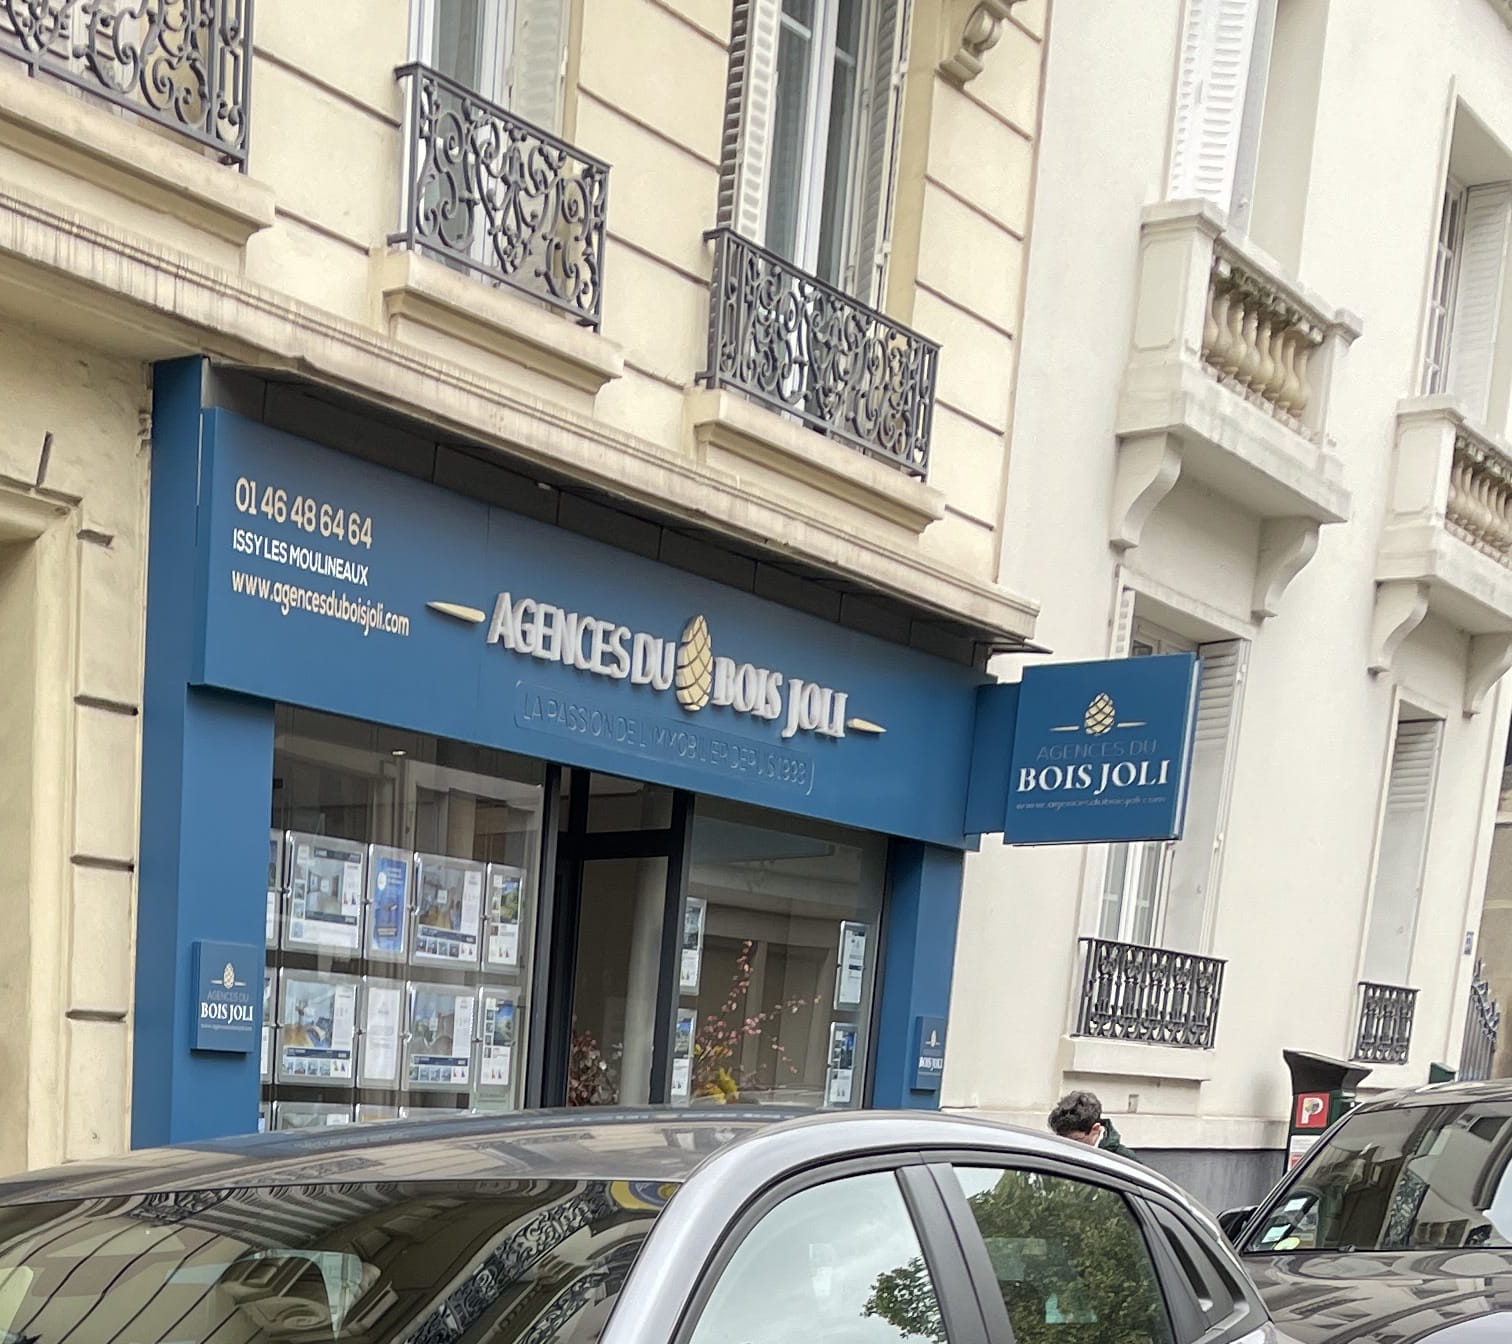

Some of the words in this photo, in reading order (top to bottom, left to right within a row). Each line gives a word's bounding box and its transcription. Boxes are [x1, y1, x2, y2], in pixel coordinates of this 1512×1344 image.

[235, 477, 257, 515] 01
[261, 486, 287, 523] 46
[290, 496, 317, 532] 48
[320, 504, 345, 541] 64
[348, 512, 373, 549] 64
[233, 528, 263, 555] ISSY
[264, 537, 288, 563] LES
[290, 544, 369, 586] MOULINEAUX
[232, 570, 410, 636] www.agencesduboisjoli.com
[487, 592, 631, 679] AGENCES
[631, 633, 676, 690] DU
[711, 656, 783, 719] BOIS
[781, 678, 849, 738] JOLI
[1036, 740, 1124, 761] AGENCES
[1130, 738, 1157, 756] DU
[1016, 763, 1093, 793] BOIS
[1093, 759, 1171, 795] JOLI
[201, 1002, 228, 1019] BOIS
[227, 1004, 254, 1024] JOLI
[1300, 1097, 1324, 1124] P
